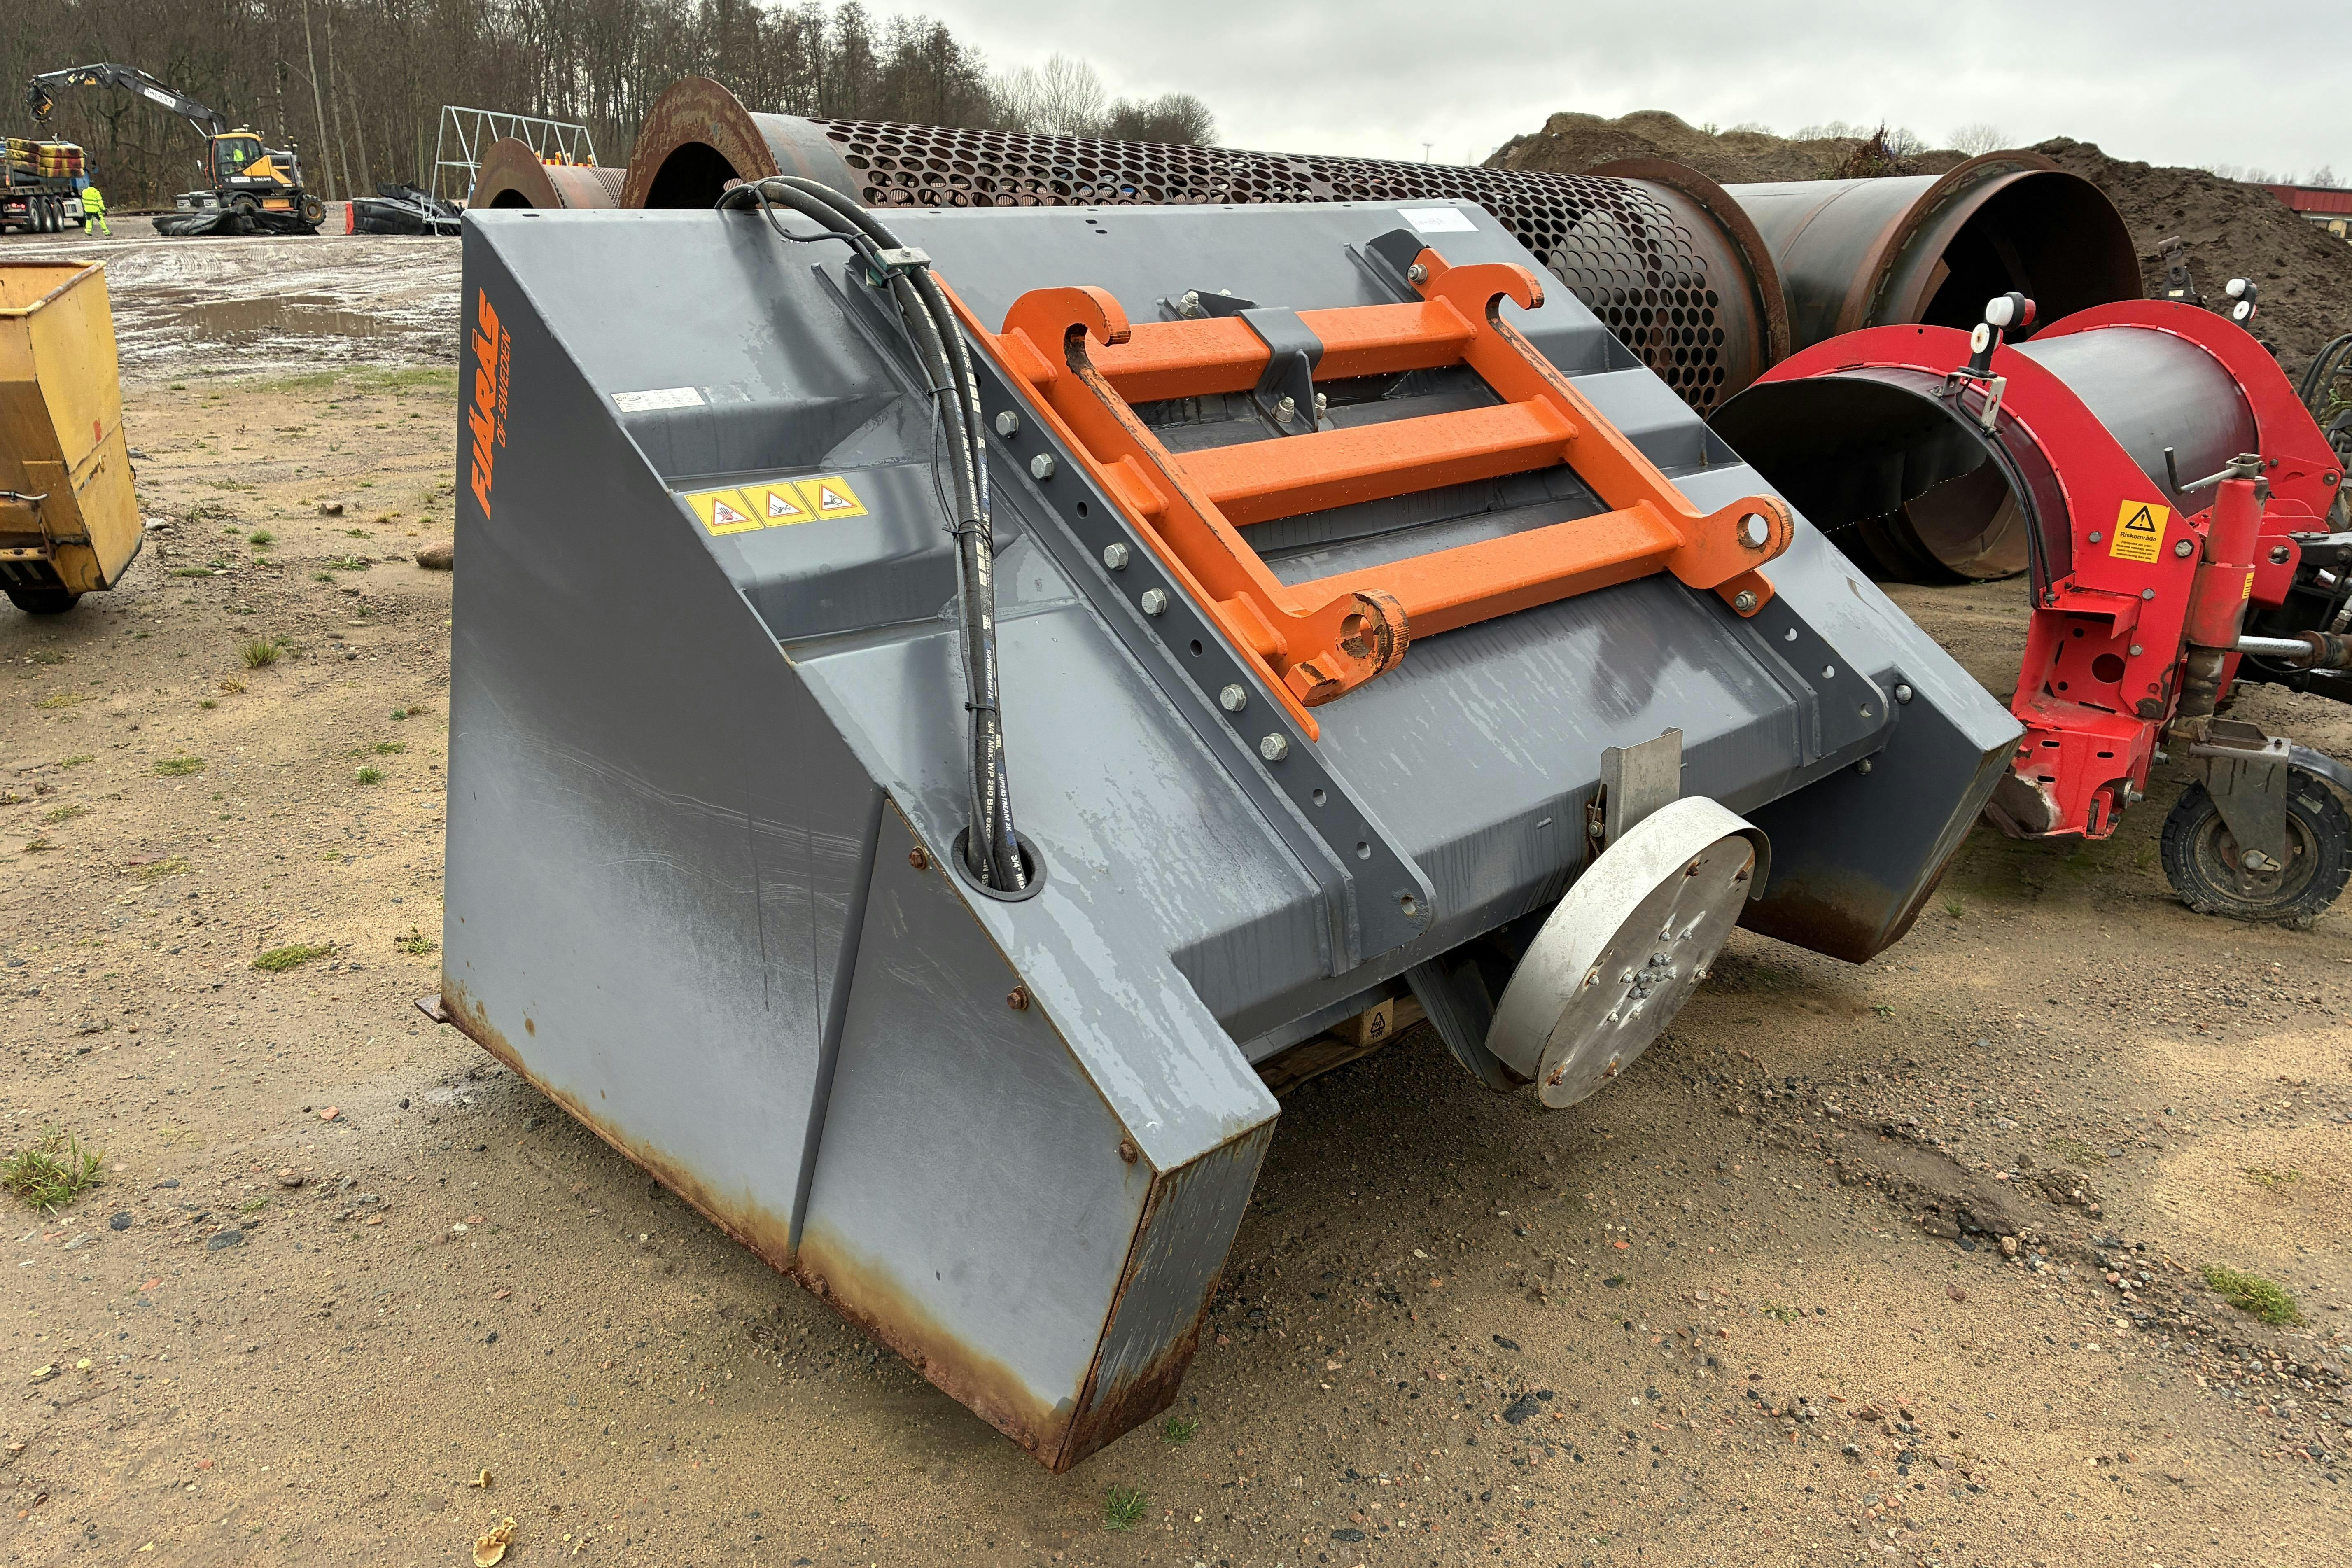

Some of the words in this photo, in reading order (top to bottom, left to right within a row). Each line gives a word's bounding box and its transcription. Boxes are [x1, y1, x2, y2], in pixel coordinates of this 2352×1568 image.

[958, 338, 966, 348] EN
[499, 325, 511, 419] SWEDEN
[497, 415, 506, 448] OF
[2120, 532, 2157, 542] Riskområde
[988, 690, 993, 700] 2K
[987, 762, 994, 778] WP
[998, 772, 1010, 821] SUPERSTREAM
[1005, 820, 1012, 831] 2K
[1010, 855, 1021, 871] 3/4"
[1372, 1030, 1383, 1039] FOR
